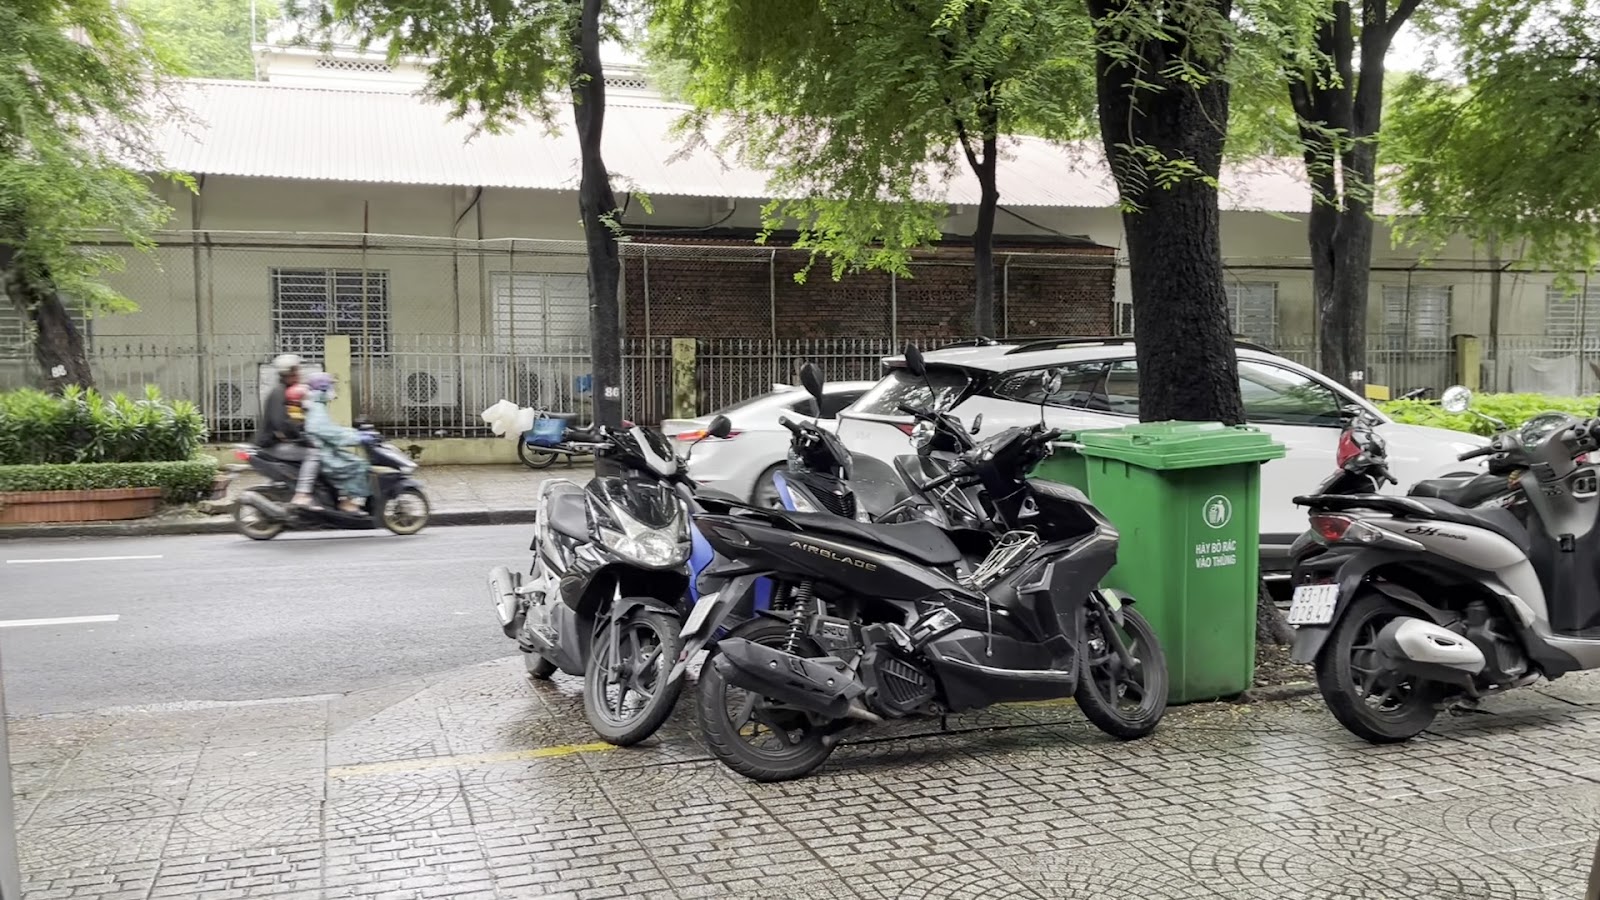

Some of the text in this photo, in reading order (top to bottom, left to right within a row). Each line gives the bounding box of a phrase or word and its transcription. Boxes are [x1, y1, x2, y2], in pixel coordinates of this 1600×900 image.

[604, 386, 620, 398] 86
[1222, 538, 1237, 552] RÁC
[789, 541, 878, 572] AIRBLADE
[1195, 553, 1237, 569] VÀO THÙNG
